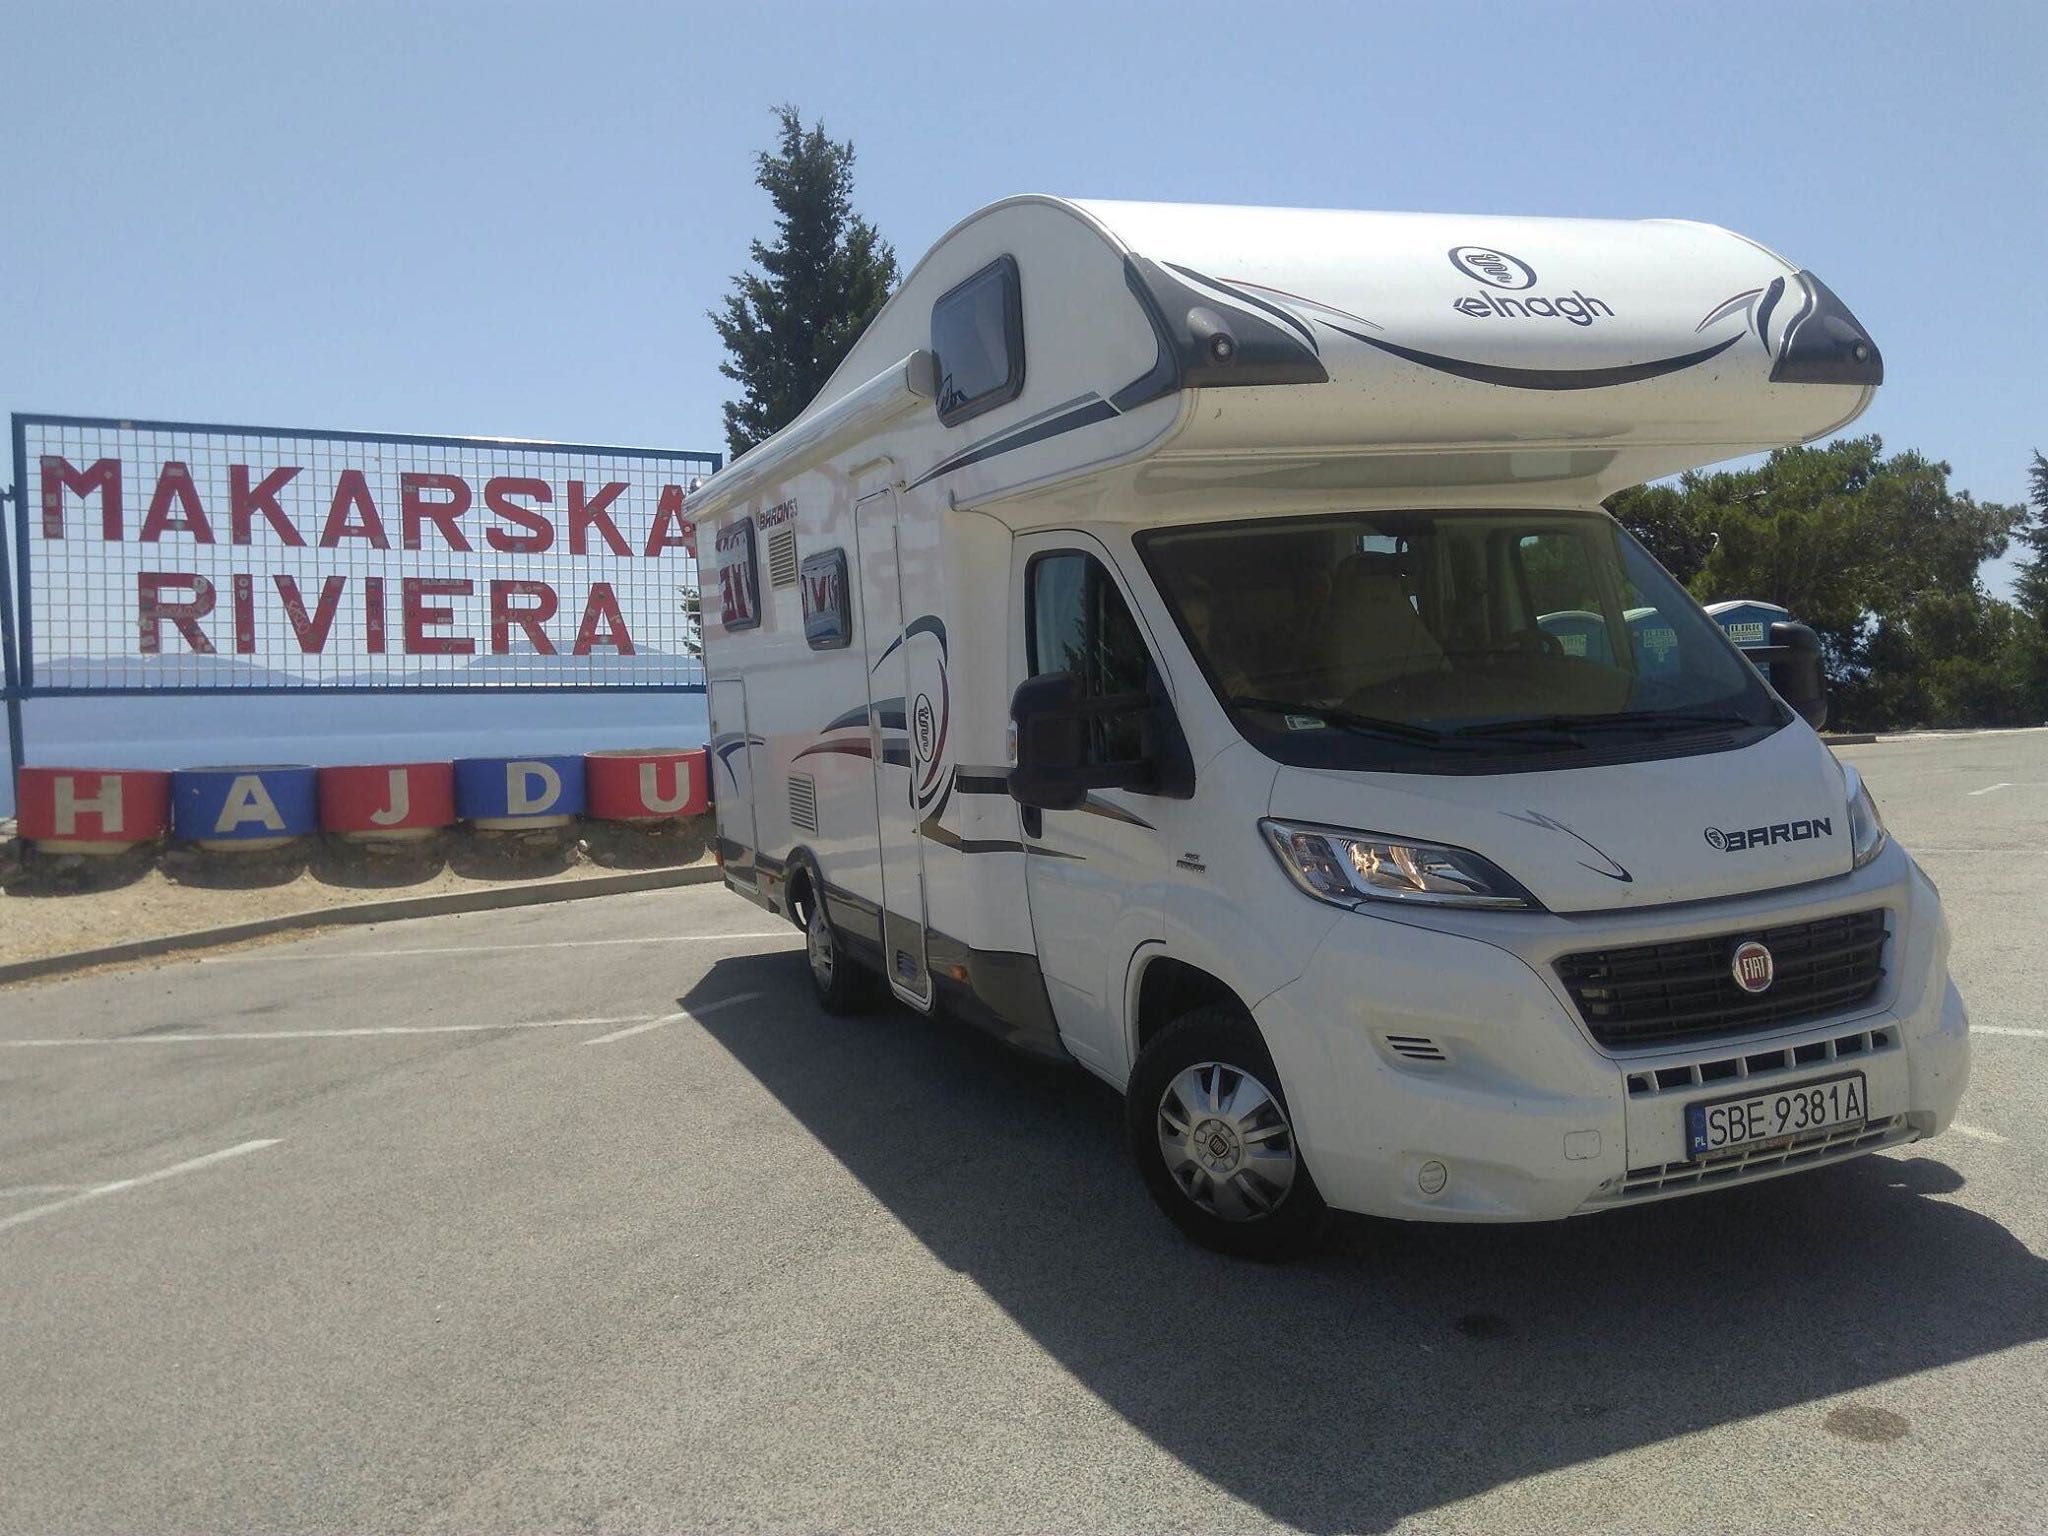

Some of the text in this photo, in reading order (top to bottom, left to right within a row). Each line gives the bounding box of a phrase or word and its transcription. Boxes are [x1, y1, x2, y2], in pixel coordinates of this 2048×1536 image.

[1452, 290, 1616, 327] elnagh
[40, 455, 697, 557] MAKARSKA
[138, 571, 636, 656] RIVIERA
[1724, 817, 1832, 852] BARON
[1742, 956, 1767, 979] FIAT
[1709, 1082, 1861, 1146] SBE 9381A
[1695, 1136, 1707, 1147] PL
